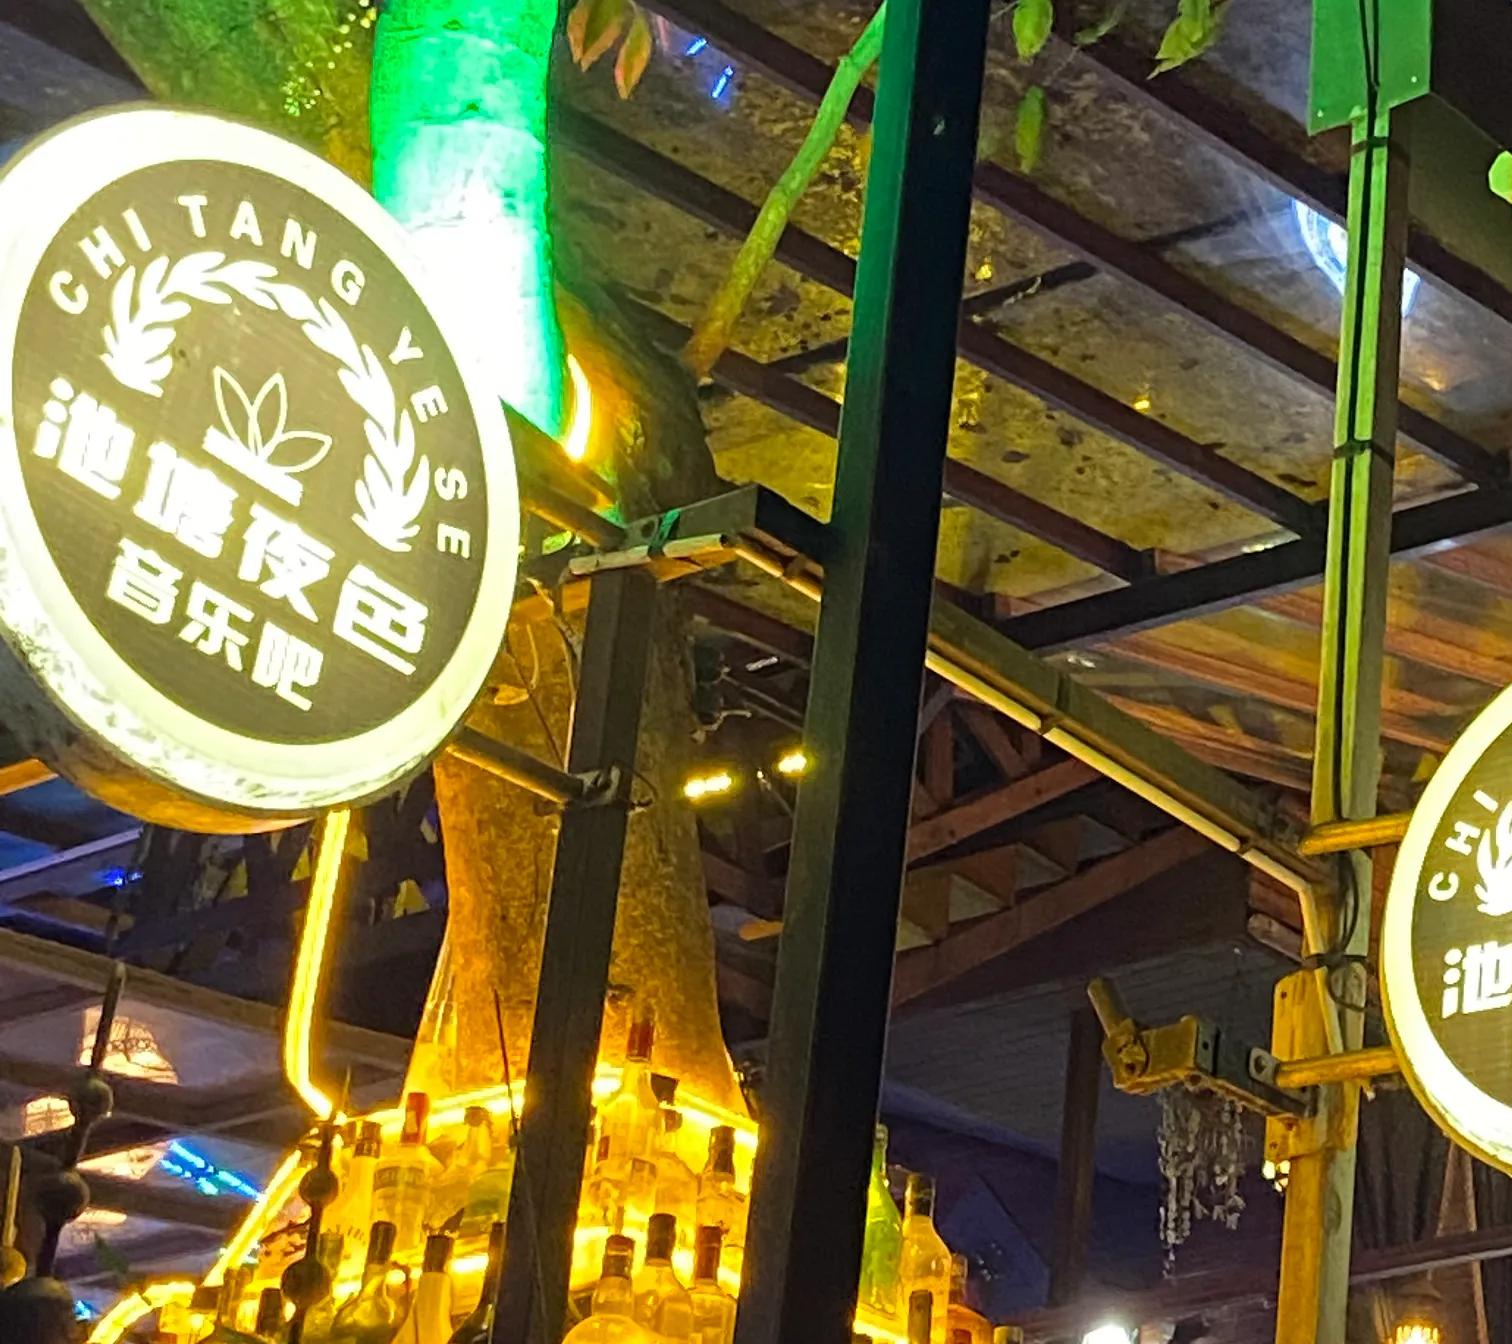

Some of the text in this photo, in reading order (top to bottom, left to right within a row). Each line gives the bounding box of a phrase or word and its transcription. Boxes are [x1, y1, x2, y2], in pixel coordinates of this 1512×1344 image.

[48, 193, 471, 560] CHI TANG YE SE
[32, 376, 431, 676] 池塘夜色
[105, 537, 324, 711] 音乐吧
[1428, 789, 1501, 903] CHI
